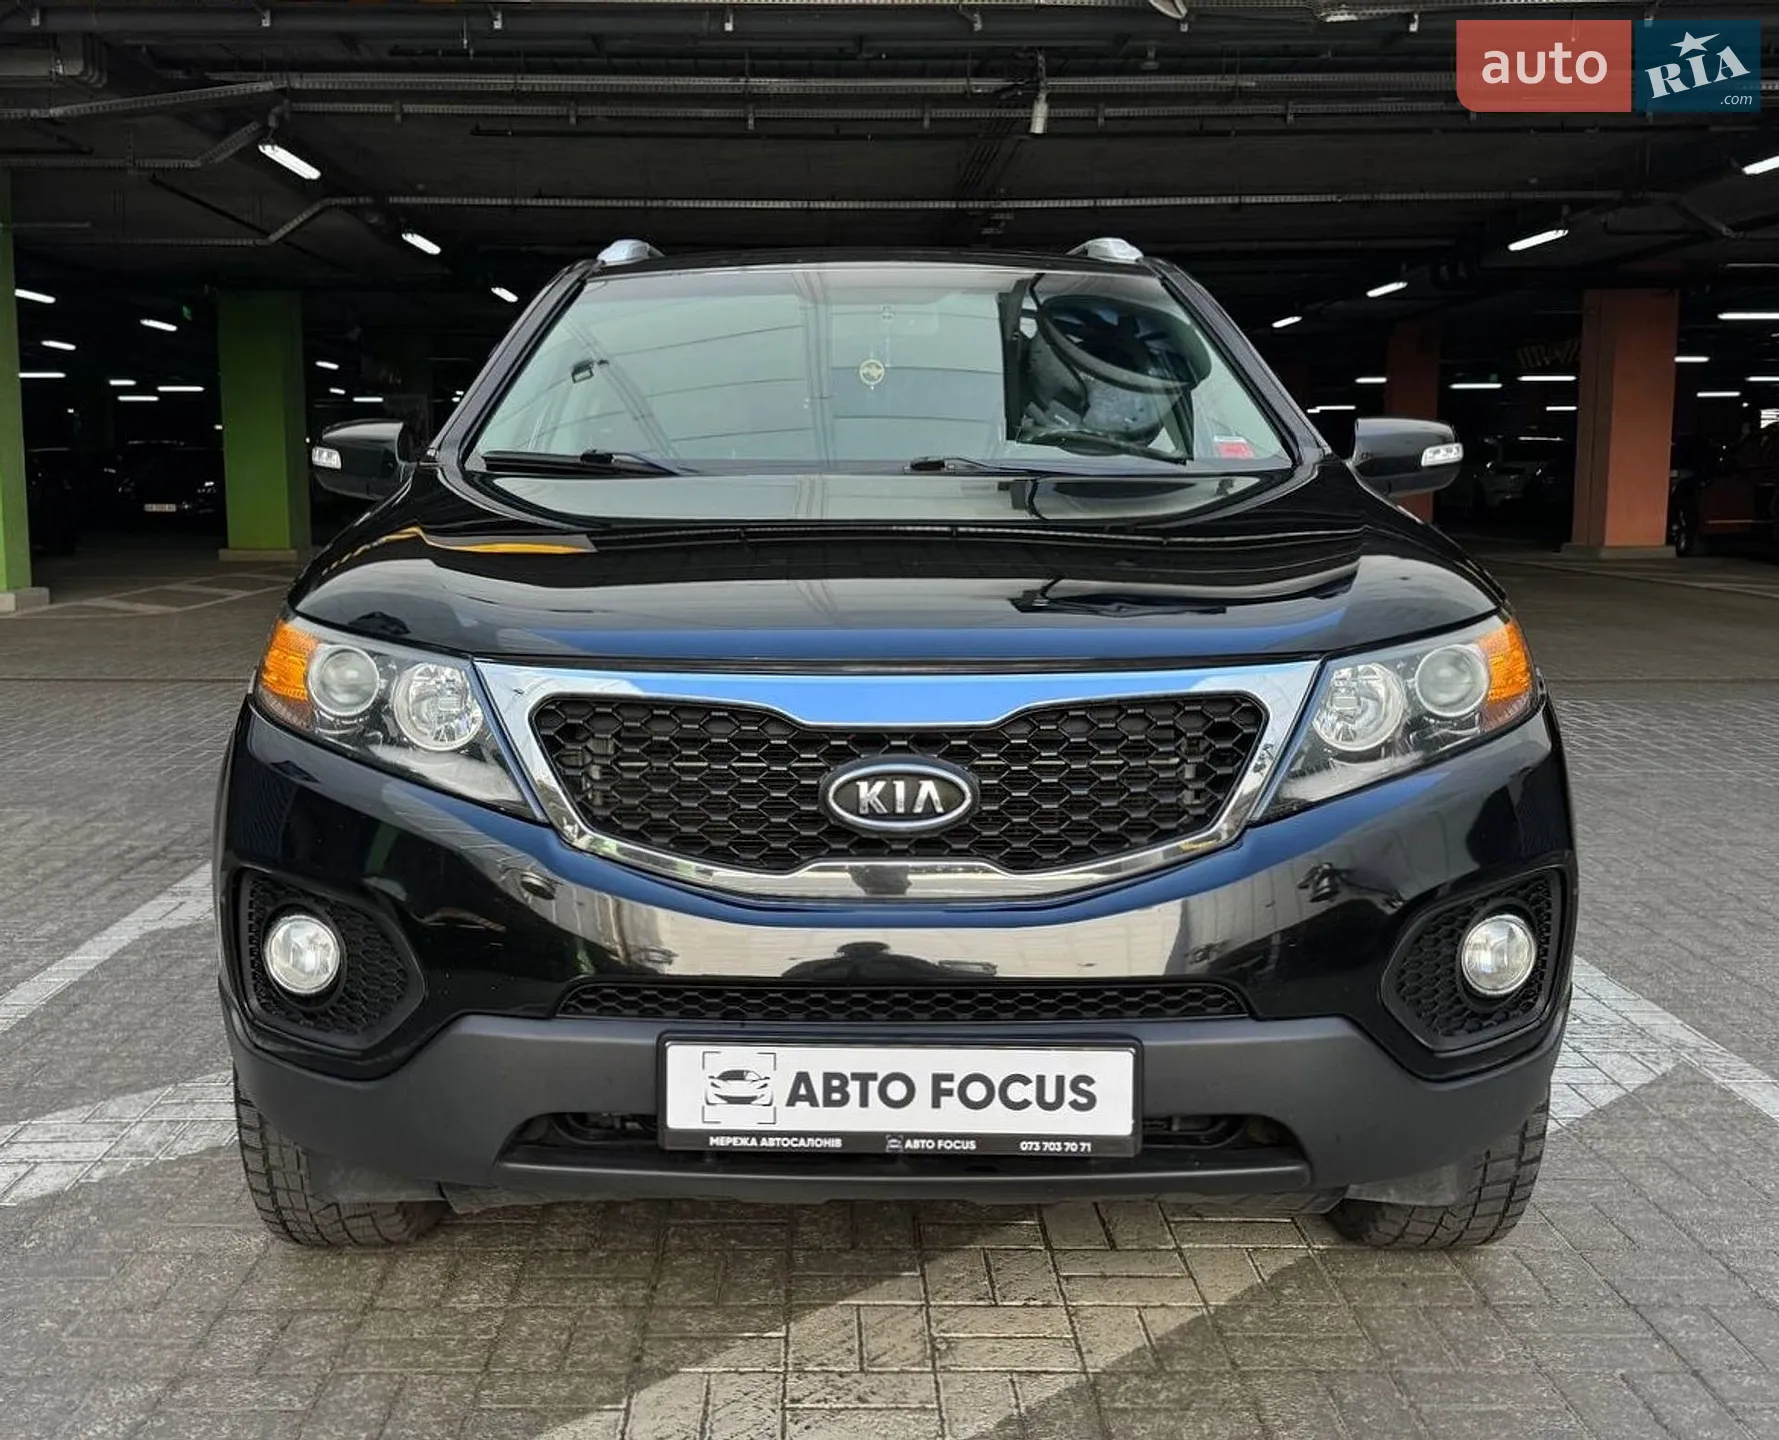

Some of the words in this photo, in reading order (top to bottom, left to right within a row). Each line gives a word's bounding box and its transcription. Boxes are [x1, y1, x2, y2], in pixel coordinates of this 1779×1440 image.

[855, 779, 945, 815] KIA
[785, 1071, 917, 1110] АВТО
[930, 1072, 1098, 1113] FOCUS
[709, 1136, 758, 1147] МЕРЕЖА
[760, 1137, 843, 1149] АВТОСАЛОНІВ
[937, 1139, 977, 1151] FOCUS
[1019, 1140, 1041, 1152] 073
[1042, 1141, 1063, 1152] 703
[1064, 1141, 1079, 1153] 70
[1080, 1142, 1092, 1153] 71
